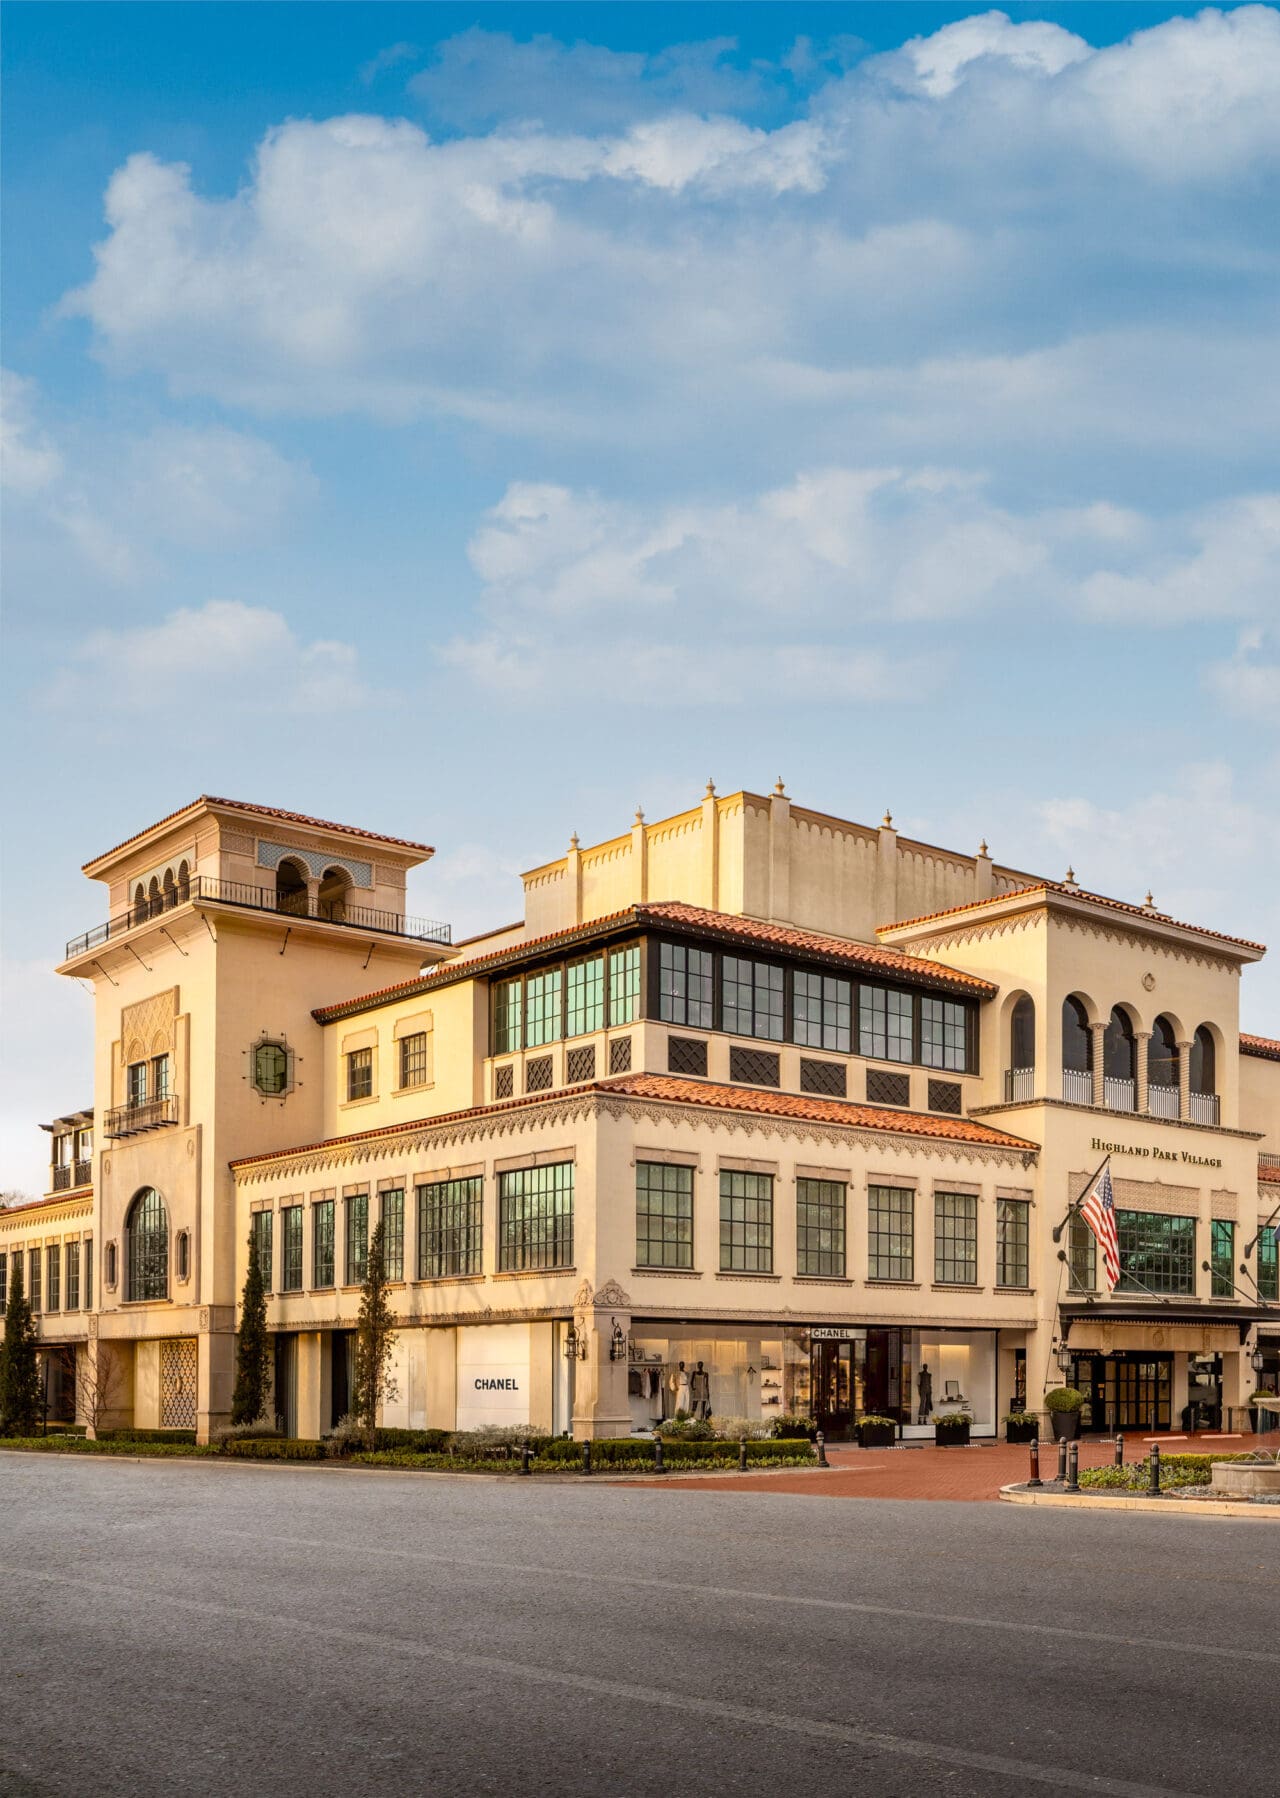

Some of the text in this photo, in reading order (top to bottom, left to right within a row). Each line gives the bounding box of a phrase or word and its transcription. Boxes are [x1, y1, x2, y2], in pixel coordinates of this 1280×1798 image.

[1091, 1138, 1223, 1168] HIGHLAND PARK VILLAGE
[813, 1329, 851, 1338] CHANEL
[474, 1378, 519, 1390] CHANEL
